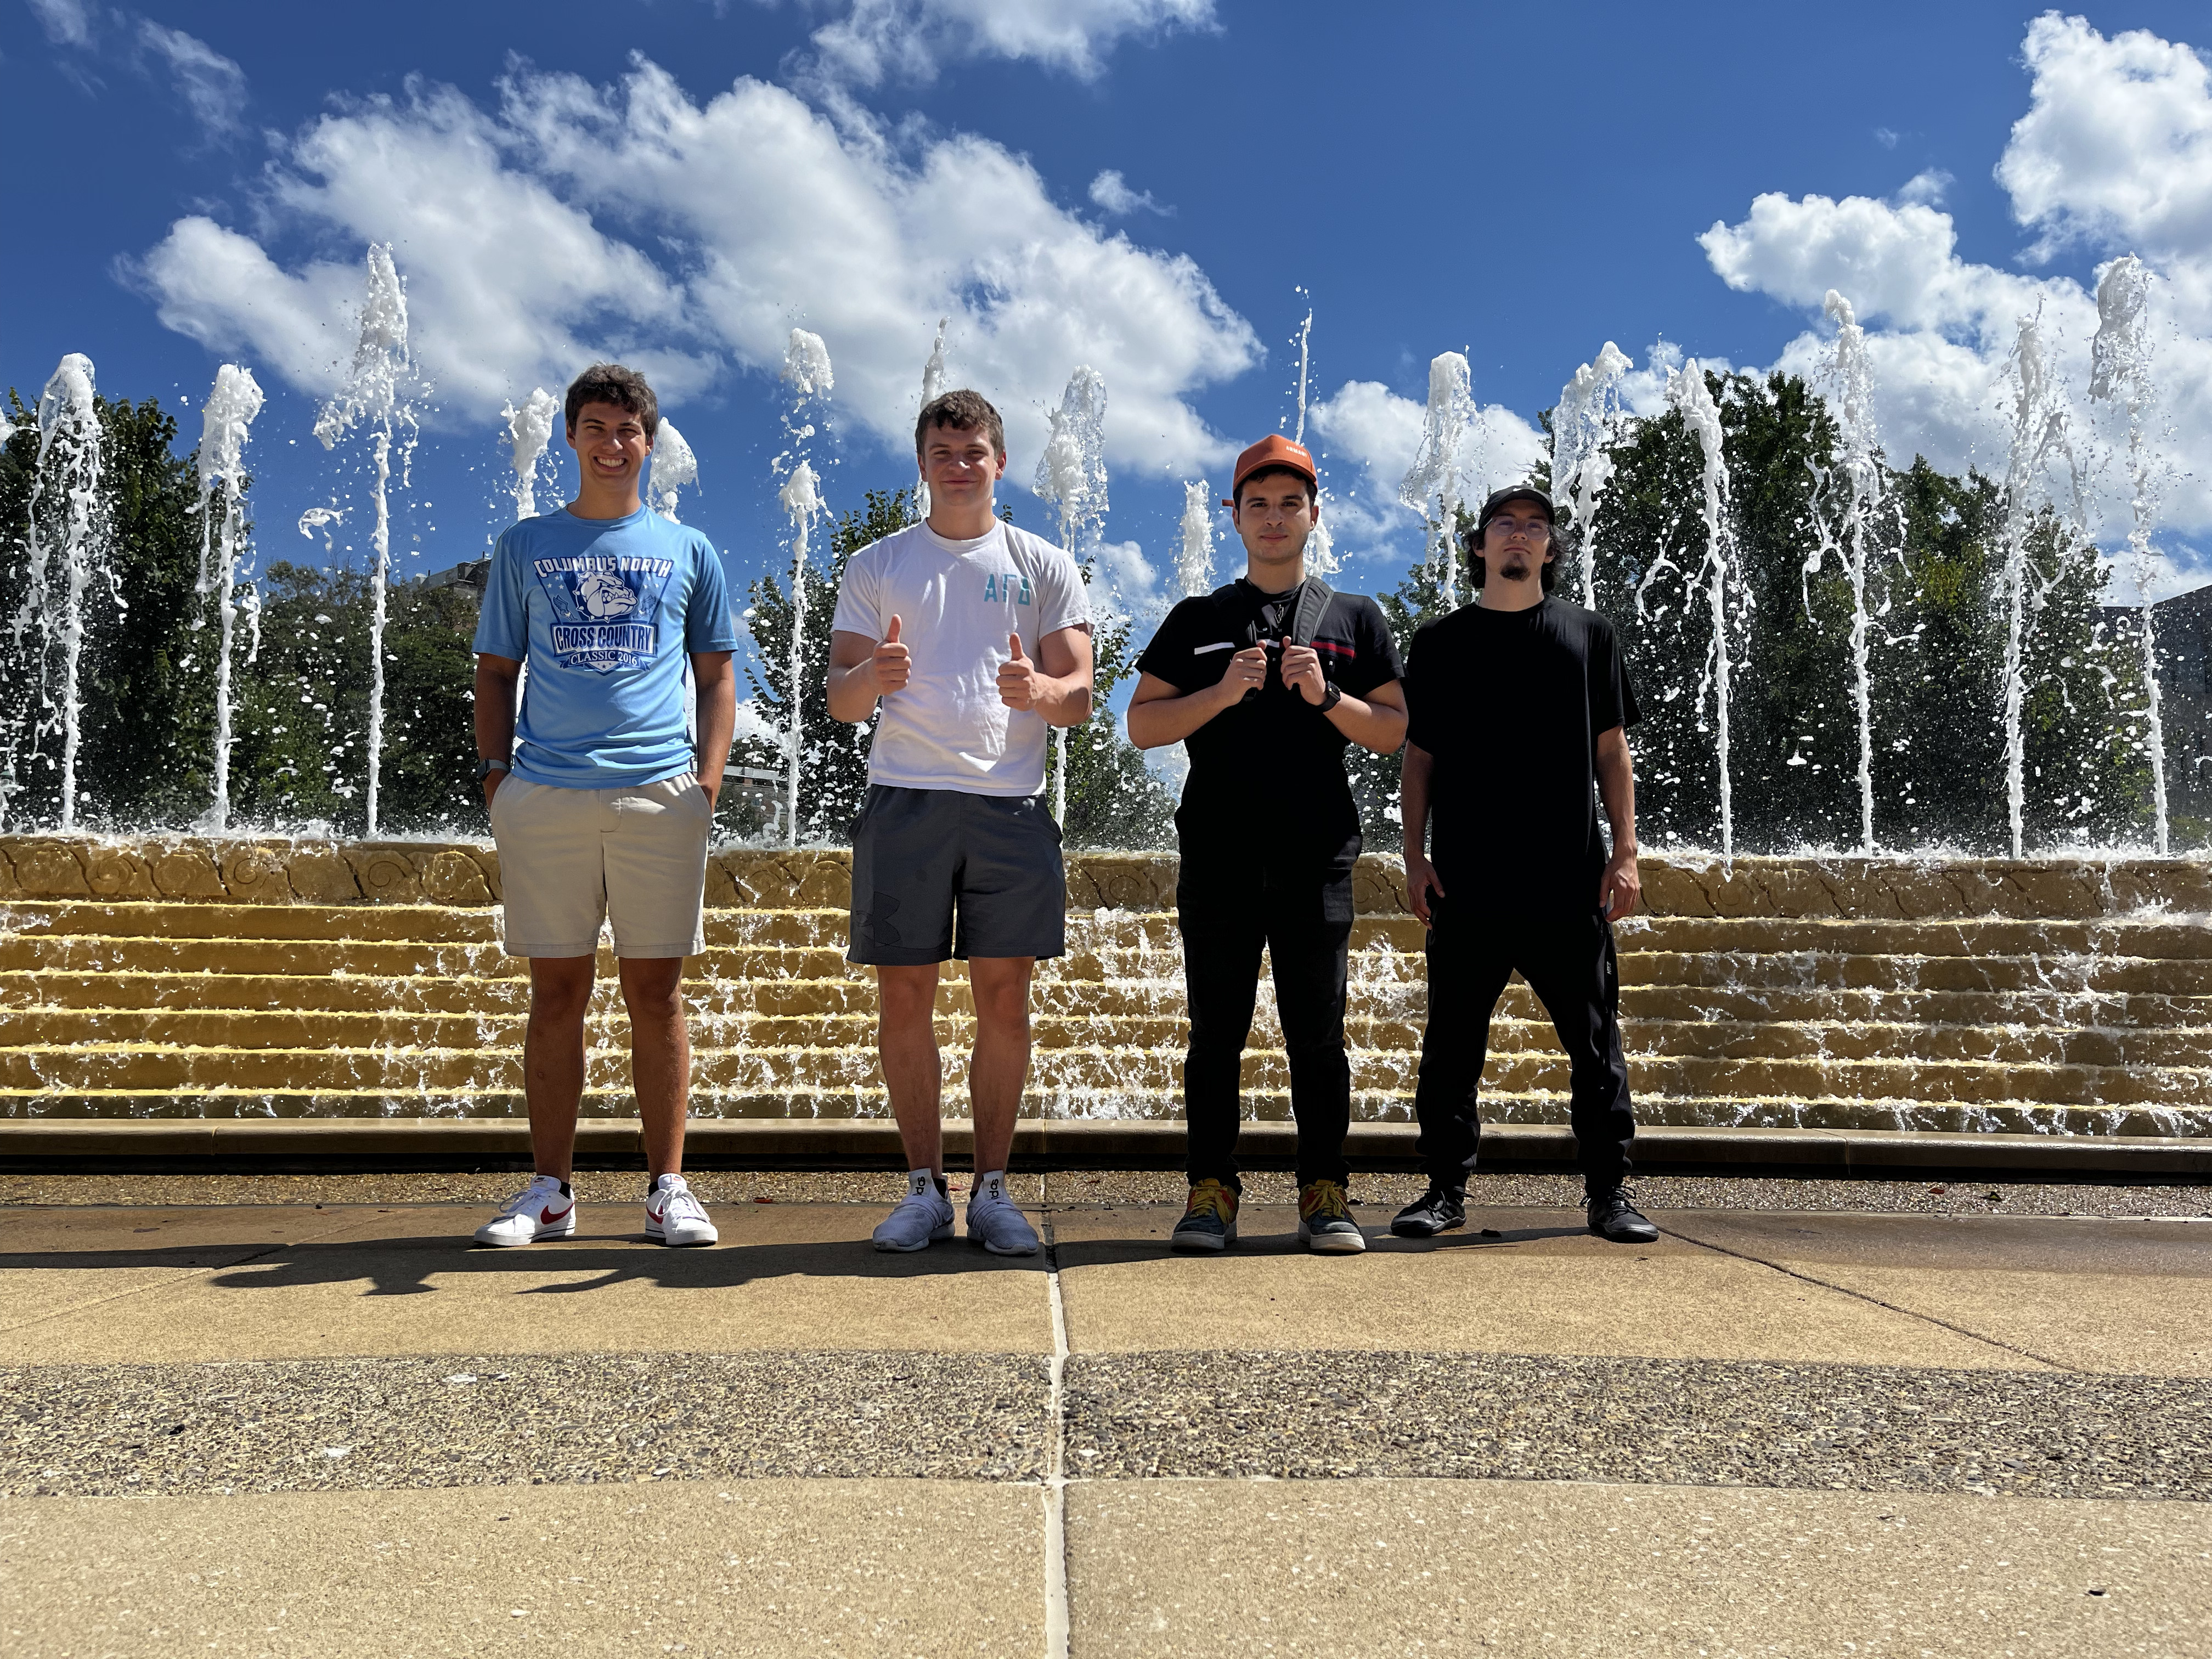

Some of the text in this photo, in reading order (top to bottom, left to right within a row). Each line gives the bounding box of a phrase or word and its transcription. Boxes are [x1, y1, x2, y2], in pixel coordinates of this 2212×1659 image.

[533, 556, 674, 578] COLUMBUS NORTH
[555, 625, 652, 652] CROSS COUNTRY
[571, 651, 637, 666] CLASSIC 2016
